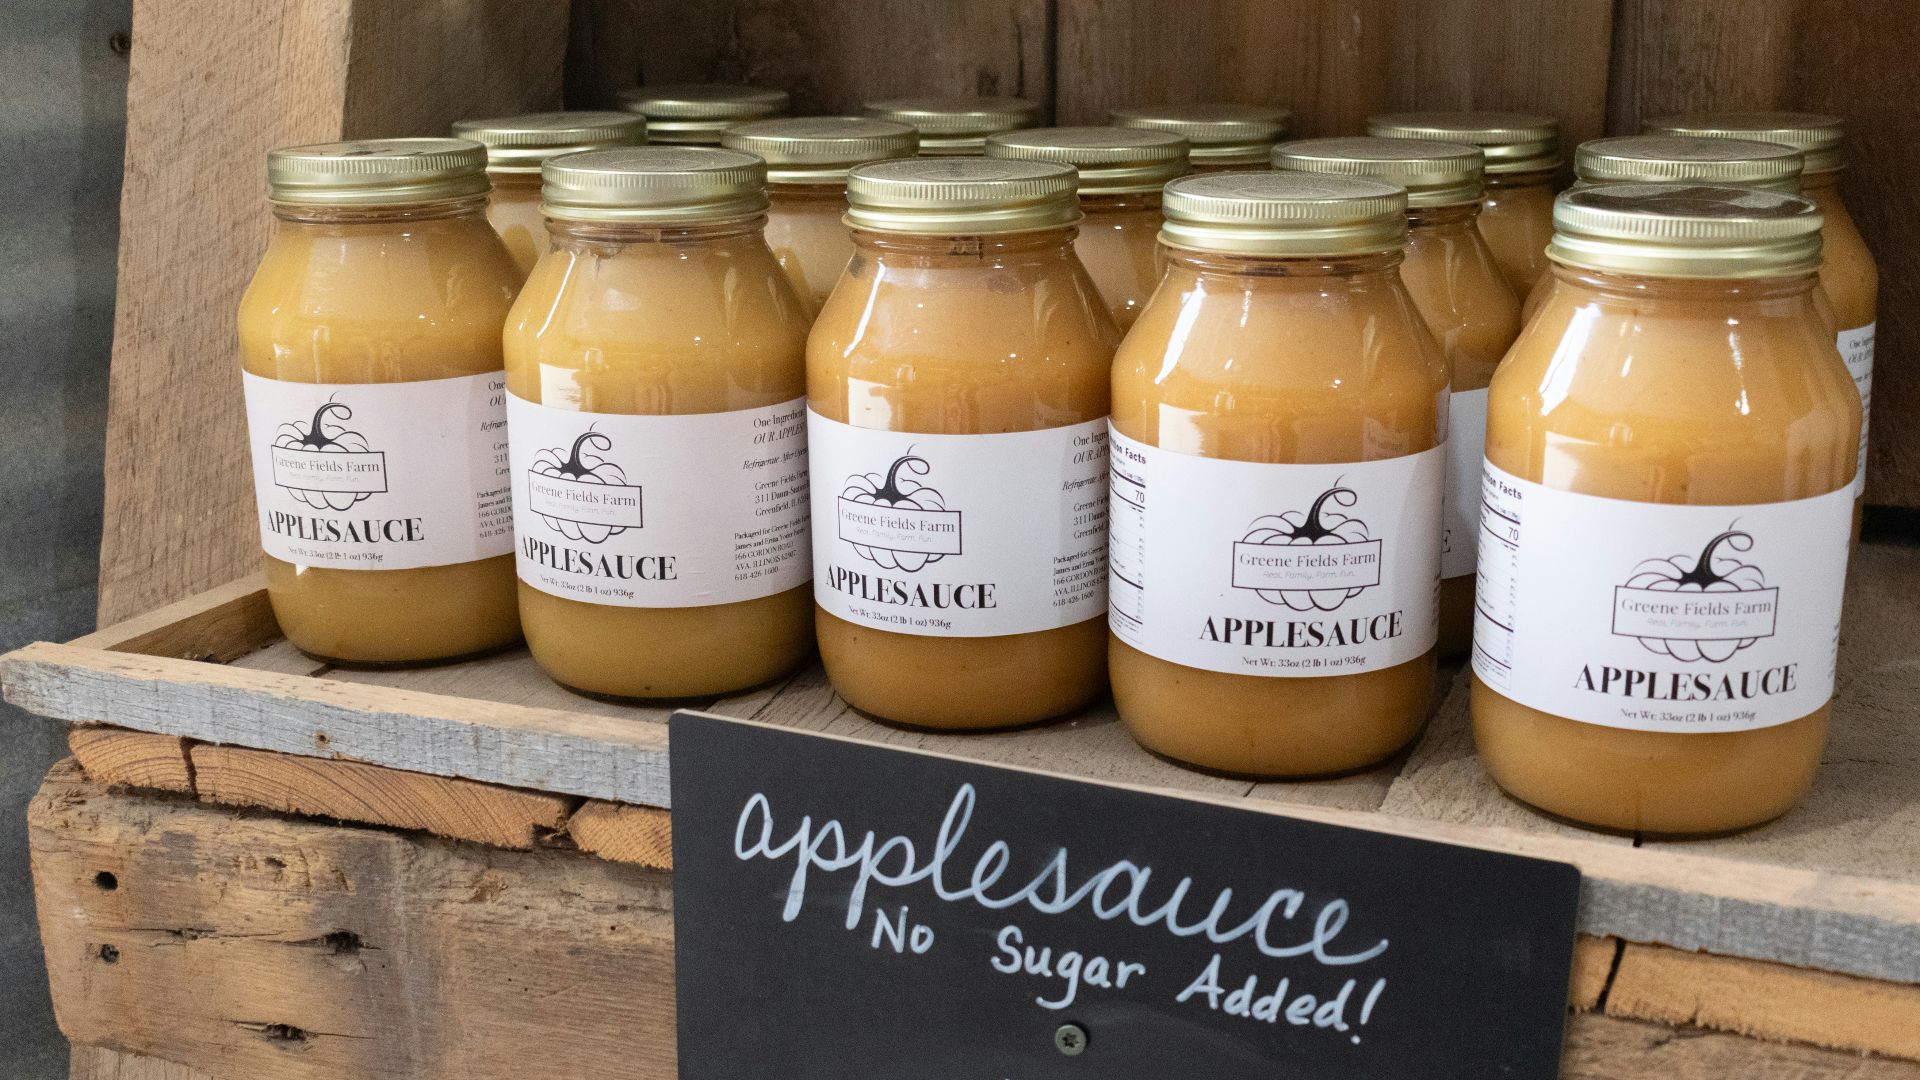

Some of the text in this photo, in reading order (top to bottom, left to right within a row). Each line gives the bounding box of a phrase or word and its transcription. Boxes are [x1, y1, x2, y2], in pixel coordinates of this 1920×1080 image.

[753, 418, 771, 428] One
[754, 431, 775, 444] OUR
[1073, 436, 1089, 447] One
[743, 456, 779, 470] Refrigerate
[1073, 450, 1093, 464] OUR
[1126, 448, 1146, 465] Facts
[276, 458, 379, 472] Greene Fields Farm
[755, 481, 778, 490] Greene
[1063, 476, 1097, 492] Refrigerate
[1500, 481, 1522, 500] Facts
[532, 481, 636, 506] Greene Fields Farm
[756, 493, 769, 503] 311
[1135, 490, 1145, 503] 70
[1074, 502, 1095, 512] Greene
[268, 509, 425, 543] APPLESAUCE
[842, 509, 955, 533] Greene Fields Farm
[1074, 514, 1087, 526] 311
[735, 529, 762, 539] Packaged
[1508, 527, 1519, 541] 70
[735, 543, 752, 551] James
[748, 546, 777, 557] GORDON
[362, 553, 383, 561] 936g
[521, 534, 678, 580] APPLESAUCE
[753, 556, 780, 568] ILLINOIS
[1054, 552, 1079, 564] Packaged
[1240, 553, 1376, 568] Greene Fields Farm
[1054, 567, 1070, 576] James
[1072, 563, 1081, 571] and
[560, 579, 576, 590] 33oz
[600, 588, 611, 596] oz)
[613, 589, 634, 598] 936g
[825, 563, 997, 610] APPLESAUCE
[1054, 578, 1065, 586] 166
[1621, 599, 1771, 616] Greene Fields Farm
[849, 604, 859, 615] Net
[872, 611, 889, 622] 33oz
[891, 615, 899, 624] (2
[900, 616, 907, 624] lb
[915, 619, 927, 627] oz)
[929, 620, 952, 630] 936g
[1199, 610, 1403, 648] APPLESAUCE
[1242, 657, 1258, 666] Net
[1278, 658, 1300, 667] 33oz
[1302, 658, 1311, 668] (2
[1313, 658, 1321, 667] lb
[1330, 658, 1343, 667] oz)
[1345, 656, 1366, 666] 936g
[1574, 662, 1799, 701] APPLESAUCE
[1621, 708, 1638, 719] Net
[1659, 711, 1684, 721] 33oz
[1686, 711, 1695, 723] (2
[1697, 712, 1707, 721] lb
[1717, 711, 1732, 722] oz)
[1733, 710, 1757, 721] 936g
[735, 783, 1389, 965] applesauce
[871, 905, 1387, 1044] No Sugar Added!
